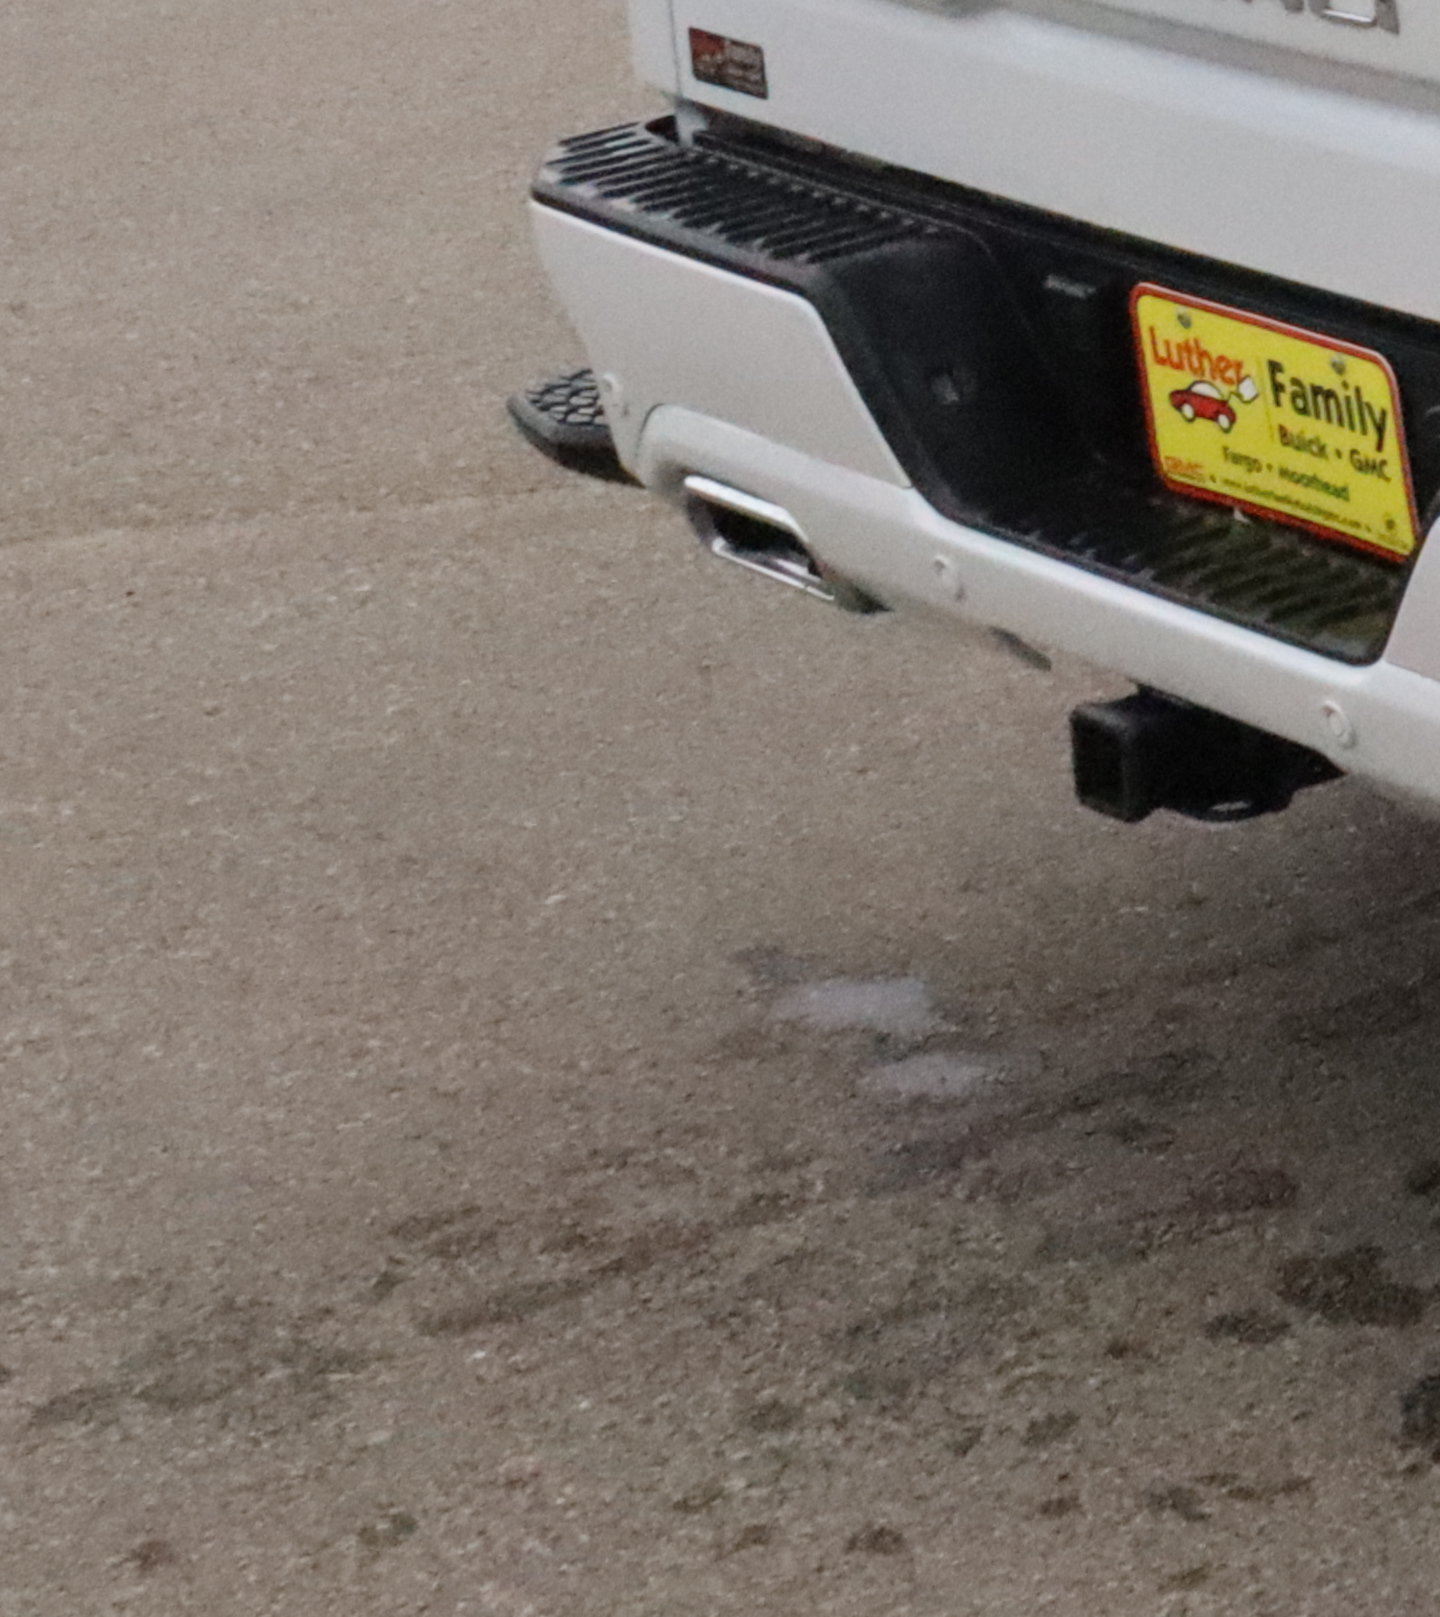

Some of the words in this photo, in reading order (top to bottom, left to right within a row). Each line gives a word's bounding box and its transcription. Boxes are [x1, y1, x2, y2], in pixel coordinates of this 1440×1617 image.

[1149, 326, 1243, 385] Luther
[1267, 359, 1387, 452] Family
[1278, 424, 1329, 461] Buick
[1350, 450, 1392, 482] GMC
